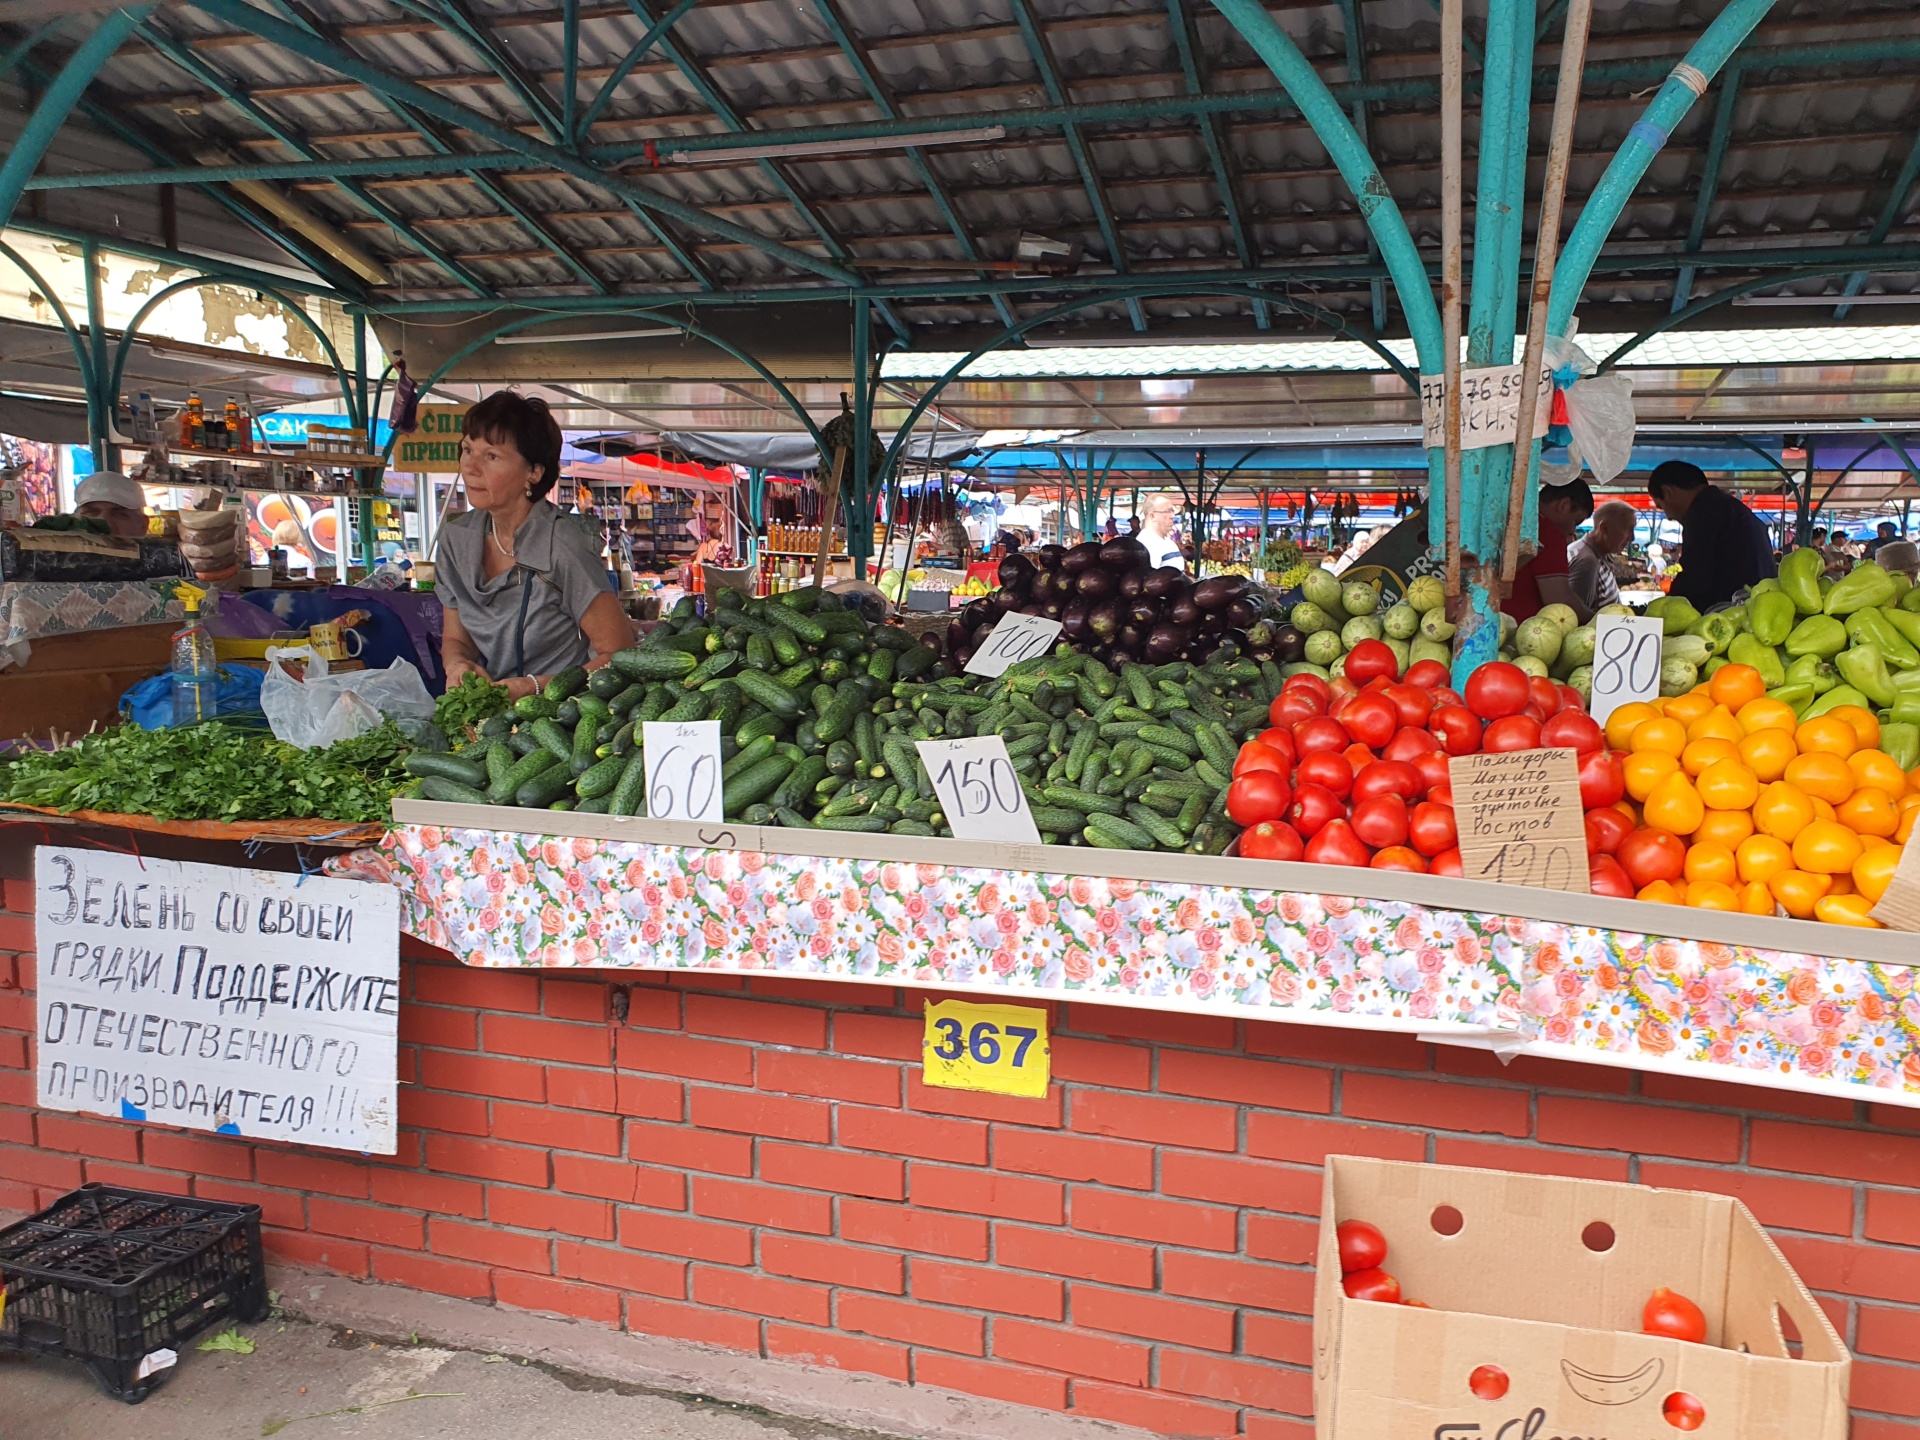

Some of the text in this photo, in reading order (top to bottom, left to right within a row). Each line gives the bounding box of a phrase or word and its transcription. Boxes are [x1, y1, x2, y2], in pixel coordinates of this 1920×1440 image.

[988, 625, 1052, 662] 100
[1594, 627, 1660, 694] 80
[650, 745, 715, 819] 60
[937, 758, 1020, 817] 150
[1472, 750, 1568, 770] Помидоры
[1472, 784, 1550, 801] сладкие
[1474, 811, 1555, 836] Ростов
[48, 855, 197, 931] ЗЕЛЕНЬ
[215, 891, 248, 935] СО
[172, 945, 398, 1020] ПОДДЕРЖИТЕ
[44, 1002, 359, 1077] ОТЕЧЕСТВЕННОГО
[933, 1018, 1038, 1068] 367
